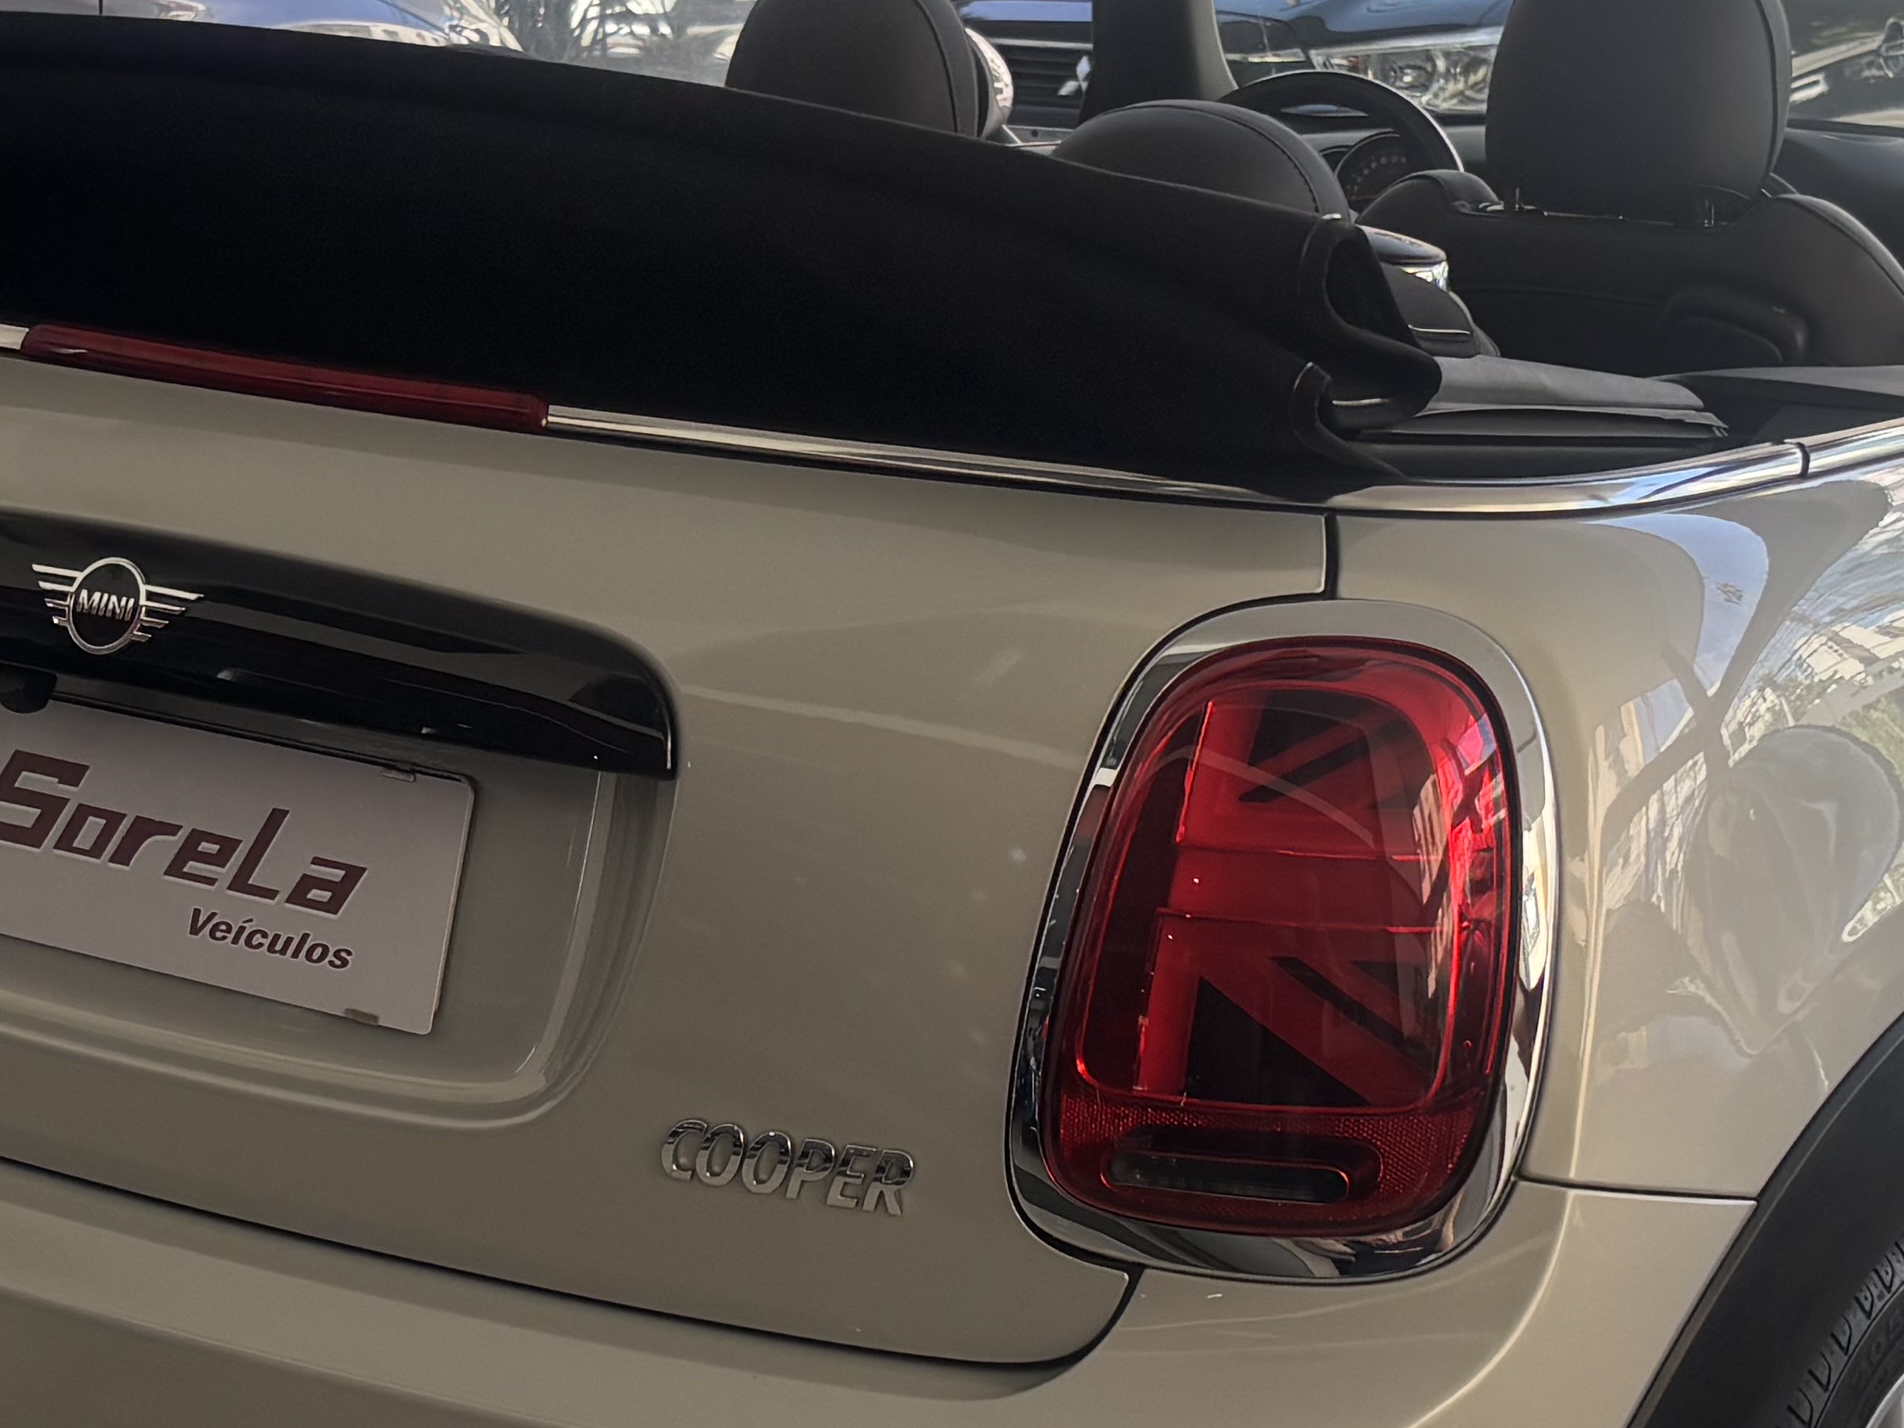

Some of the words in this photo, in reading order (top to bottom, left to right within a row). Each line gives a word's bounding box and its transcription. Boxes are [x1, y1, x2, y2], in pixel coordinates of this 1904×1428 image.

[75, 588, 136, 622] MINI
[188, 906, 353, 970] Veículos
[660, 1118, 915, 1217] COOPER
